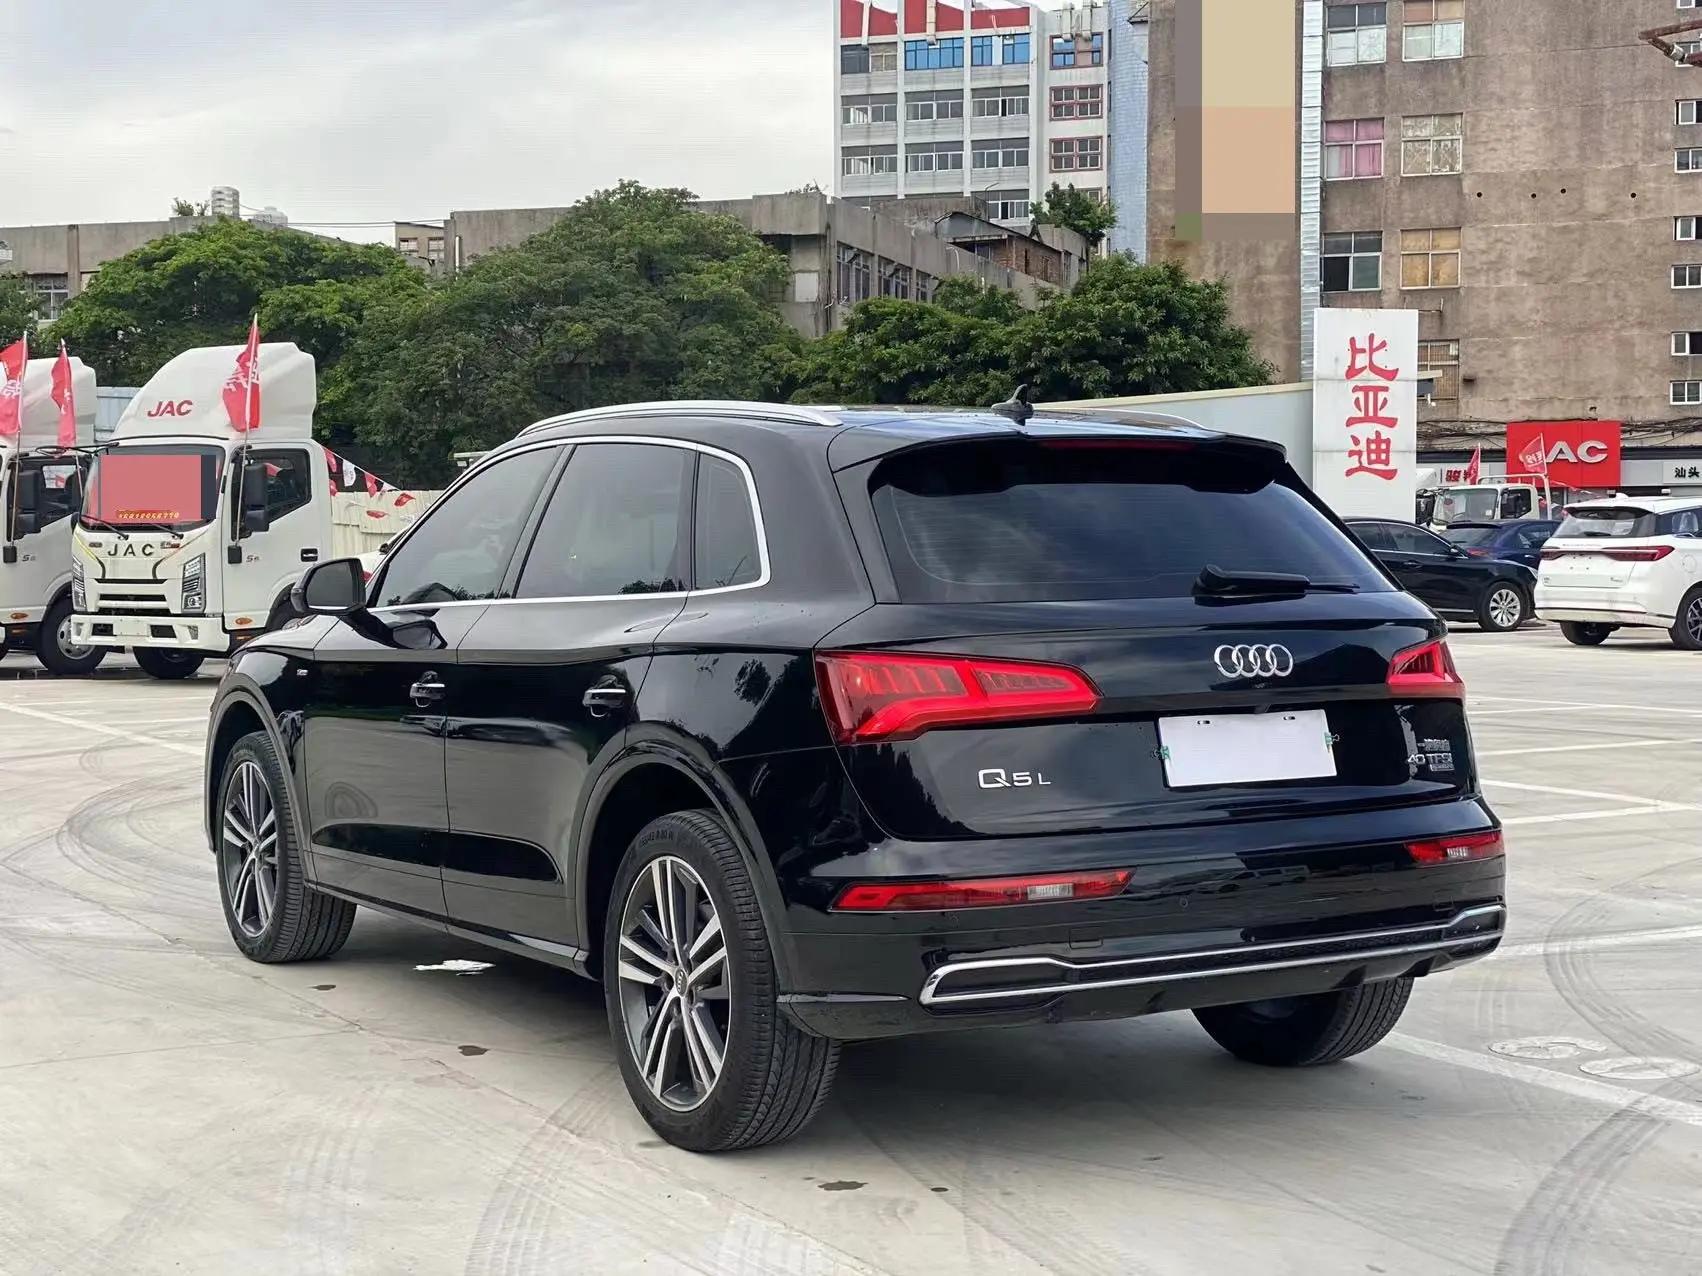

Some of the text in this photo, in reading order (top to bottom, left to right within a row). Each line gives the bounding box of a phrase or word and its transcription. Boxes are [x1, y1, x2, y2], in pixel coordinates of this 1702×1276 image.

[147, 400, 193, 417] JAC
[1345, 333, 1399, 480] 比亚迪
[1519, 439, 1608, 464] AC
[107, 543, 156, 557] JAC
[1407, 753, 1426, 765] 40
